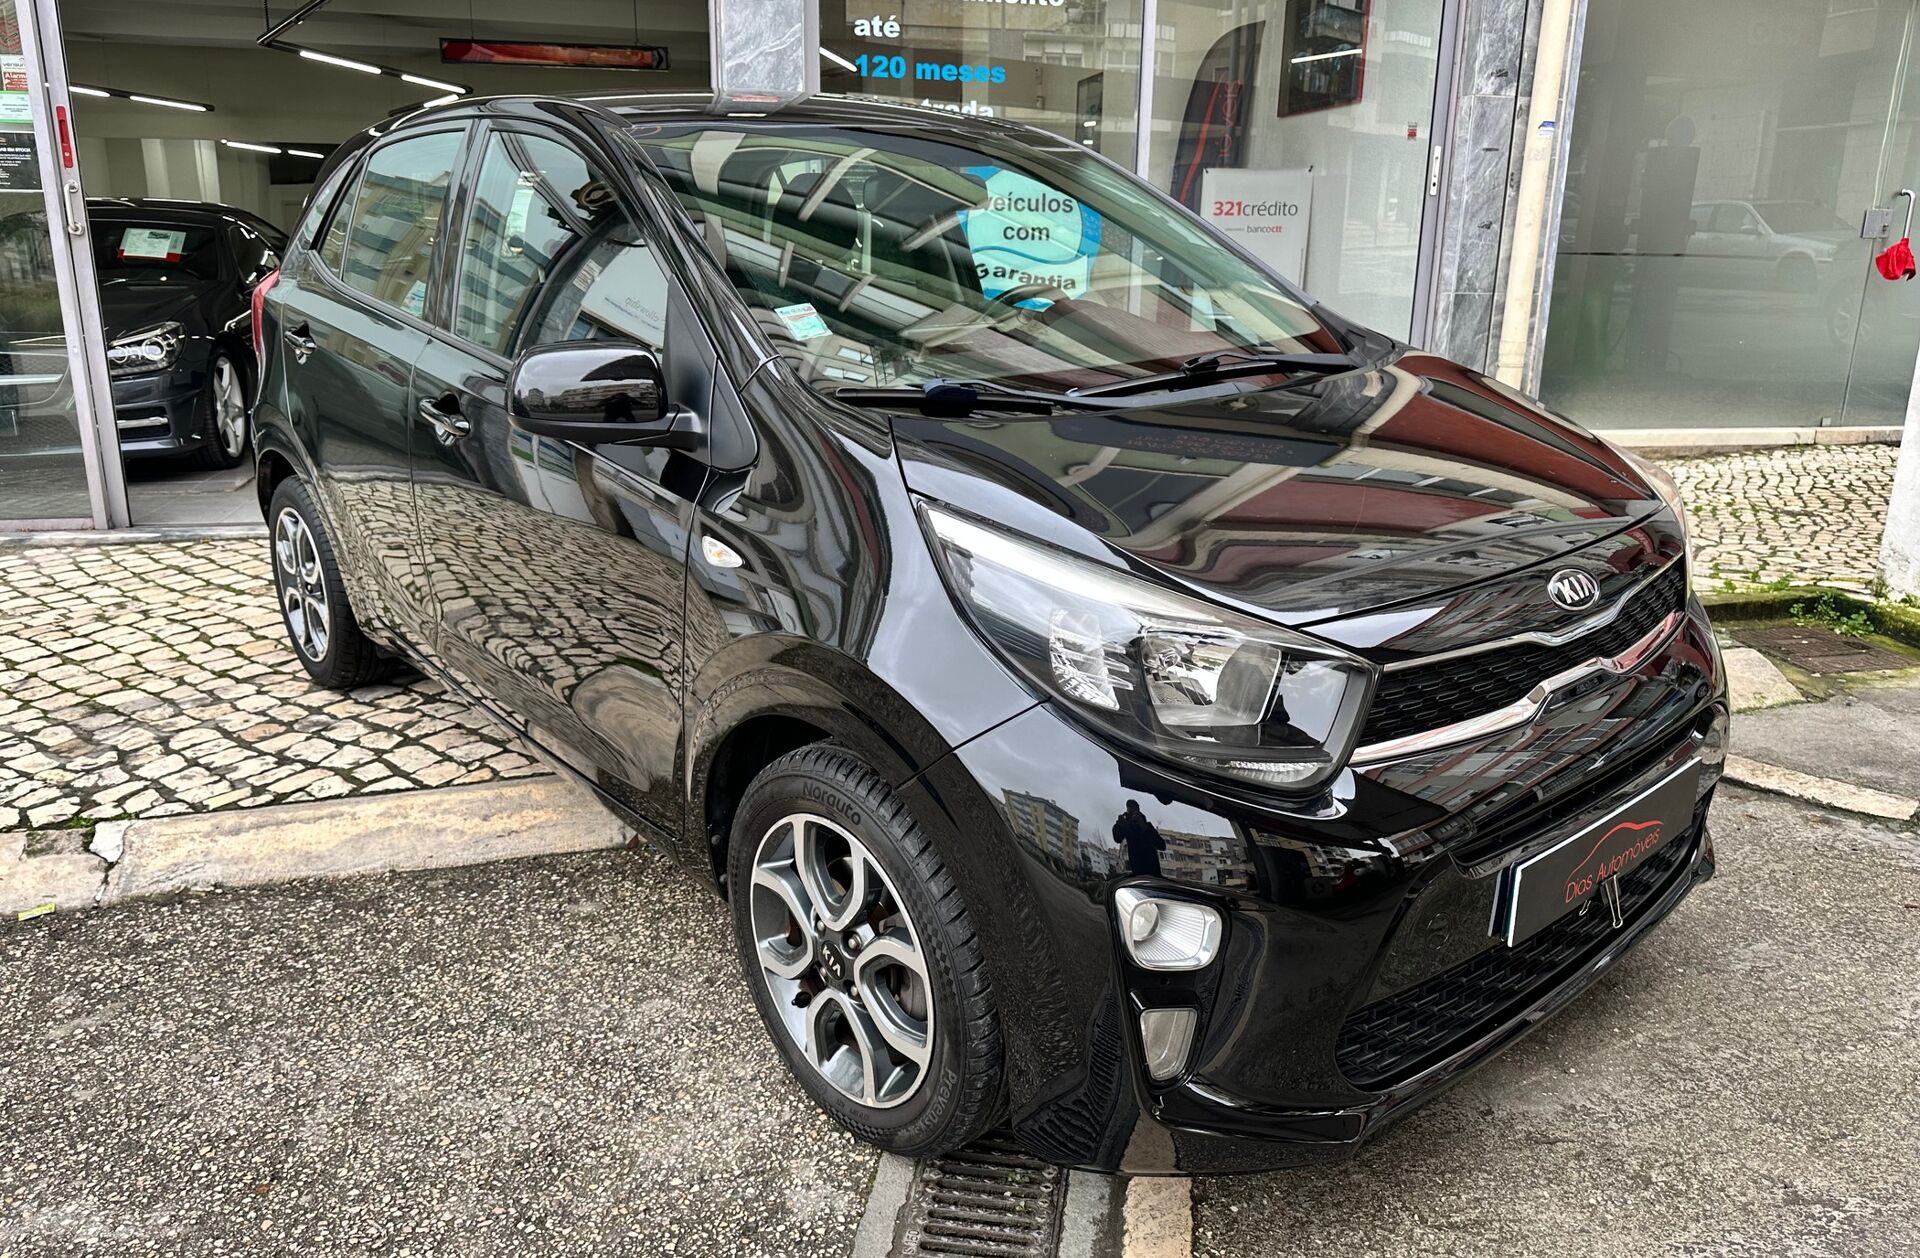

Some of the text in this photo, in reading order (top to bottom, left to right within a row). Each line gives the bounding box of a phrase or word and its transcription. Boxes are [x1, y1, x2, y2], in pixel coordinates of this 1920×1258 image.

[854, 15, 900, 37] até
[855, 55, 1007, 84] 120 meses
[1213, 200, 1298, 217] 321crédito
[1003, 226, 1050, 241] com
[1246, 224, 1282, 234] bancoctt
[975, 263, 1077, 291] Garantia
[1554, 573, 1595, 604] KIA
[802, 781, 861, 825] Norauto
[1565, 828, 1661, 904] Dias Automóveis
[822, 944, 841, 977] KIA
